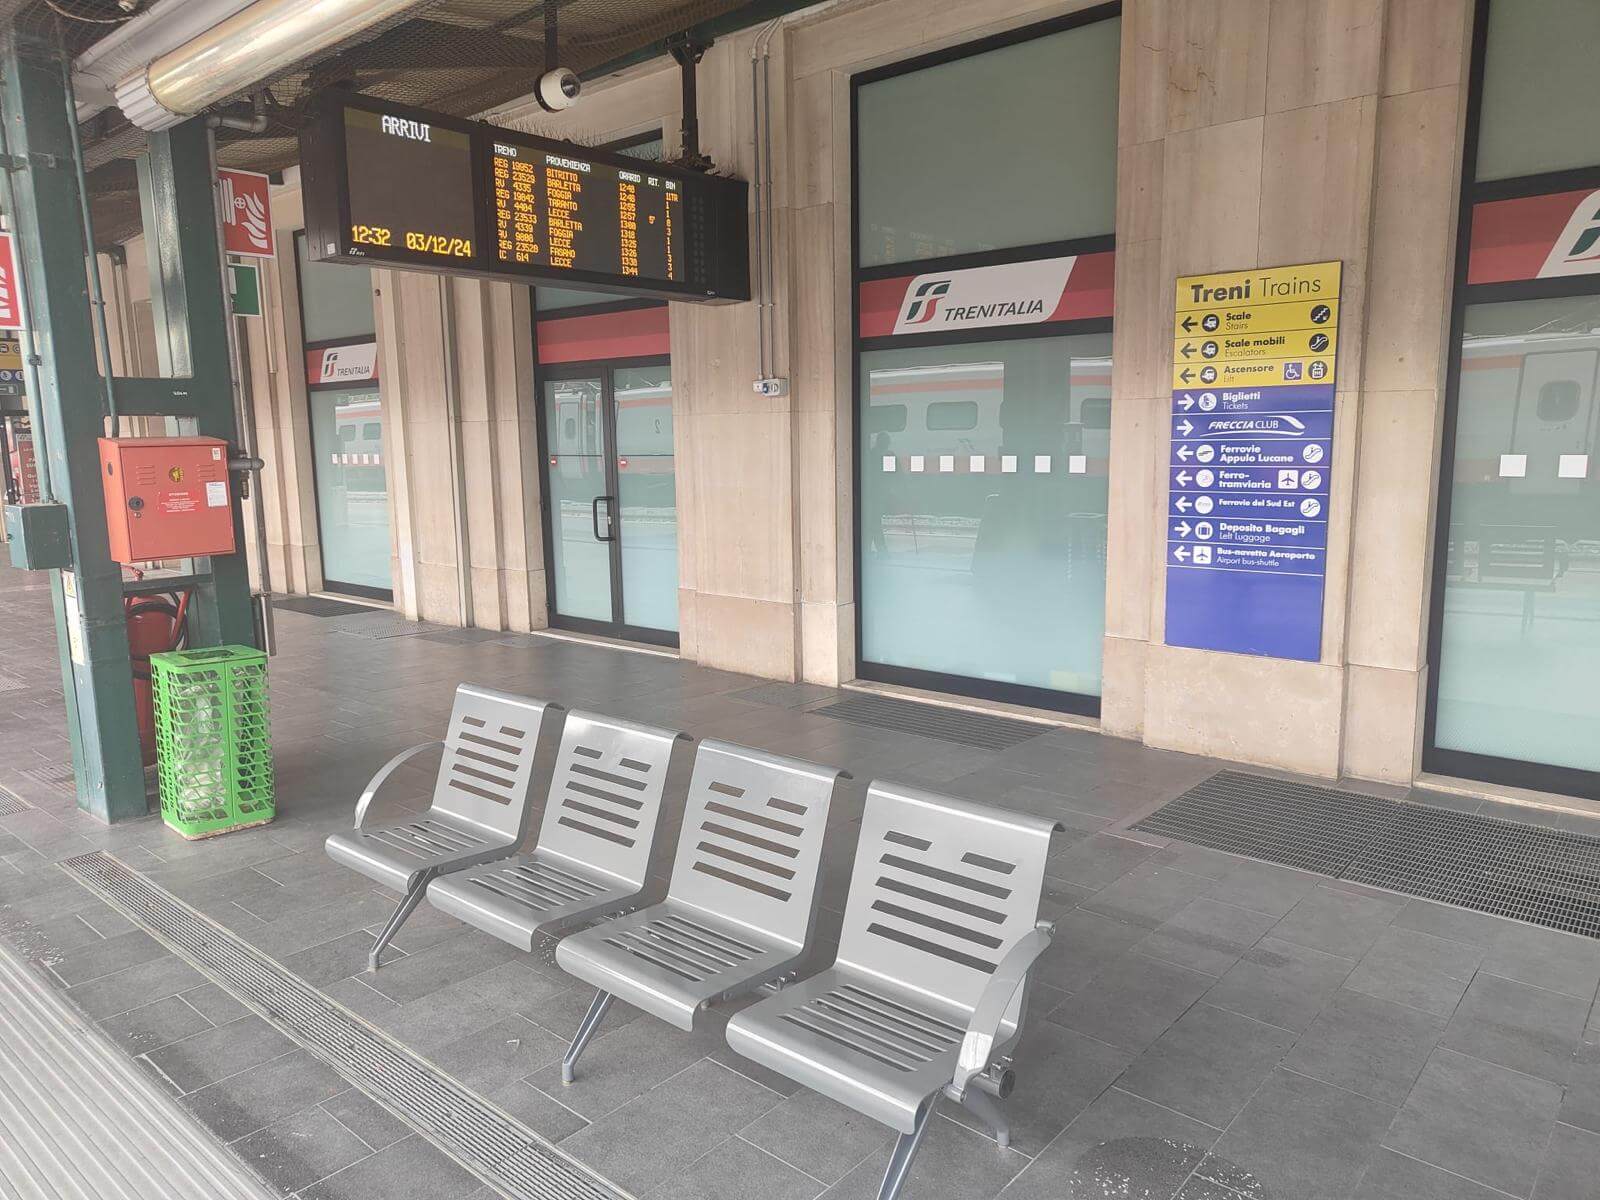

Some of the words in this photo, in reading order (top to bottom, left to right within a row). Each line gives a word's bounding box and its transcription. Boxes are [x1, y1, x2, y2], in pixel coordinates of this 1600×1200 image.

[382, 115, 432, 143] ARRIVI
[493, 144, 517, 156] TRENO
[546, 155, 590, 173] PROVENIENZA
[619, 171, 640, 183] ORARIO
[666, 180, 676, 190] BIN
[494, 157, 508, 168] REG
[546, 168, 577, 182] BITRITTO
[495, 168, 509, 179] REG
[546, 178, 581, 192] BARLETTA
[496, 188, 510, 199] REG
[548, 198, 578, 210] TARANTO
[547, 188, 571, 200] FOGGIA
[548, 208, 570, 219] LECCE
[497, 209, 511, 220] REG
[548, 217, 583, 231] BARLETTA
[549, 227, 574, 239] FOGGIA
[352, 225, 391, 246] 12:32
[406, 232, 471, 257] 03/12/24
[550, 237, 571, 248] LECCE
[498, 239, 512, 250] REG
[550, 247, 576, 258] FASANO
[499, 250, 507, 260] IC
[516, 252, 529, 262] 614
[550, 256, 572, 268] LECCE
[1191, 279, 1250, 303] Treni
[1259, 277, 1321, 297] Trains
[945, 300, 1043, 321] TRENITALIA
[1226, 311, 1252, 321] Scale
[1226, 322, 1248, 331] Stairs
[1225, 339, 1251, 348] Scale
[1253, 336, 1285, 346] mobili
[1225, 348, 1266, 358] Escalators
[337, 366, 370, 376] TRENITALIA
[1224, 364, 1274, 374] Ascensore
[1222, 392, 1260, 402] Biglietti
[1223, 402, 1248, 410] Tickets
[1220, 445, 1261, 453] Ferrovie
[1220, 454, 1255, 464] Appulo
[1258, 454, 1293, 463] Lucane
[1220, 471, 1250, 479] Ferro-
[1219, 480, 1272, 489] tramviaria
[1220, 523, 1262, 534] Deposito
[1265, 524, 1305, 536] Bagagli
[1220, 532, 1233, 540] Left
[1234, 533, 1270, 543] Luggage
[1217, 548, 1268, 558] Bus-navetta
[1270, 551, 1315, 560] Aeroporto
[1217, 556, 1241, 565] Airport
[1242, 558, 1280, 567] bus-shuttle
